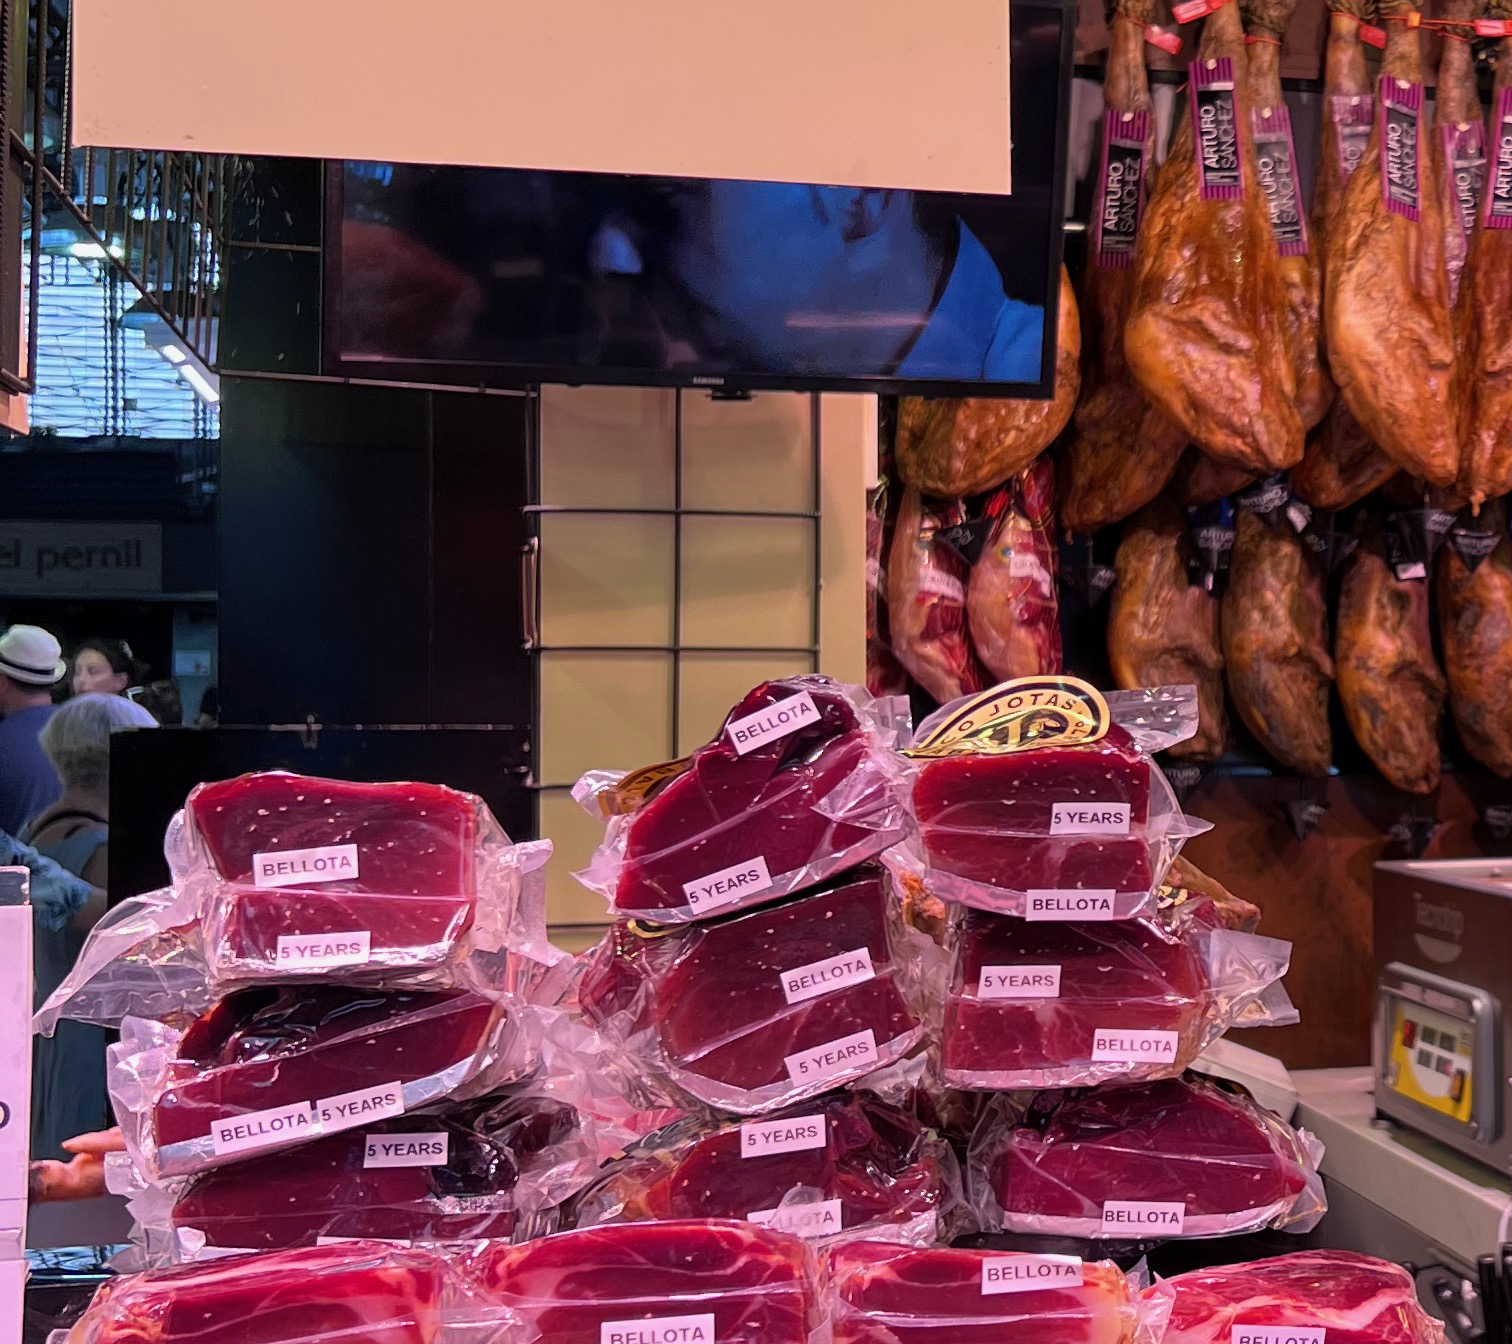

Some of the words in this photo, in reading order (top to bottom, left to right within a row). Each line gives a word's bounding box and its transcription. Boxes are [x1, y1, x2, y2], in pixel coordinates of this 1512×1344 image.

[1200, 105, 1221, 168] ARTURO
[1215, 99, 1238, 169] SANCHEZ
[1387, 122, 1402, 185] ARTURO
[1102, 161, 1125, 232] ARTURO
[1119, 157, 1142, 233] SANCHEZ
[1456, 172, 1477, 234] RTURO
[37, 538, 142, 579] pernil
[988, 692, 1077, 717] JOTAS
[734, 699, 813, 744] BELLOTA
[1053, 811, 1062, 825] 5
[1066, 810, 1124, 825] YEARS
[262, 854, 352, 878] BELLOTA
[688, 888, 701, 906] 5
[704, 867, 760, 902] YEARS
[1031, 897, 1111, 913] BELLOTA
[280, 944, 290, 959] 5
[293, 940, 362, 959] YEARS
[787, 958, 867, 994] BELLOTA
[983, 973, 993, 988] 5
[996, 972, 1055, 988] YEARS
[799, 1059, 809, 1075] 5
[812, 1040, 869, 1072] YEARS
[1096, 1037, 1173, 1054] BELLOTA
[219, 1110, 309, 1143] BELLOTA
[321, 1107, 333, 1122] 5
[334, 1092, 397, 1119] YEARS
[367, 1142, 377, 1158] 5
[381, 1139, 444, 1157] YEARS
[747, 1133, 756, 1148] 5
[760, 1126, 818, 1145] YEARS
[757, 1210, 834, 1229] LLOTA
[1104, 1208, 1181, 1225] BELLOTA
[987, 1261, 1076, 1282] BELLOTA
